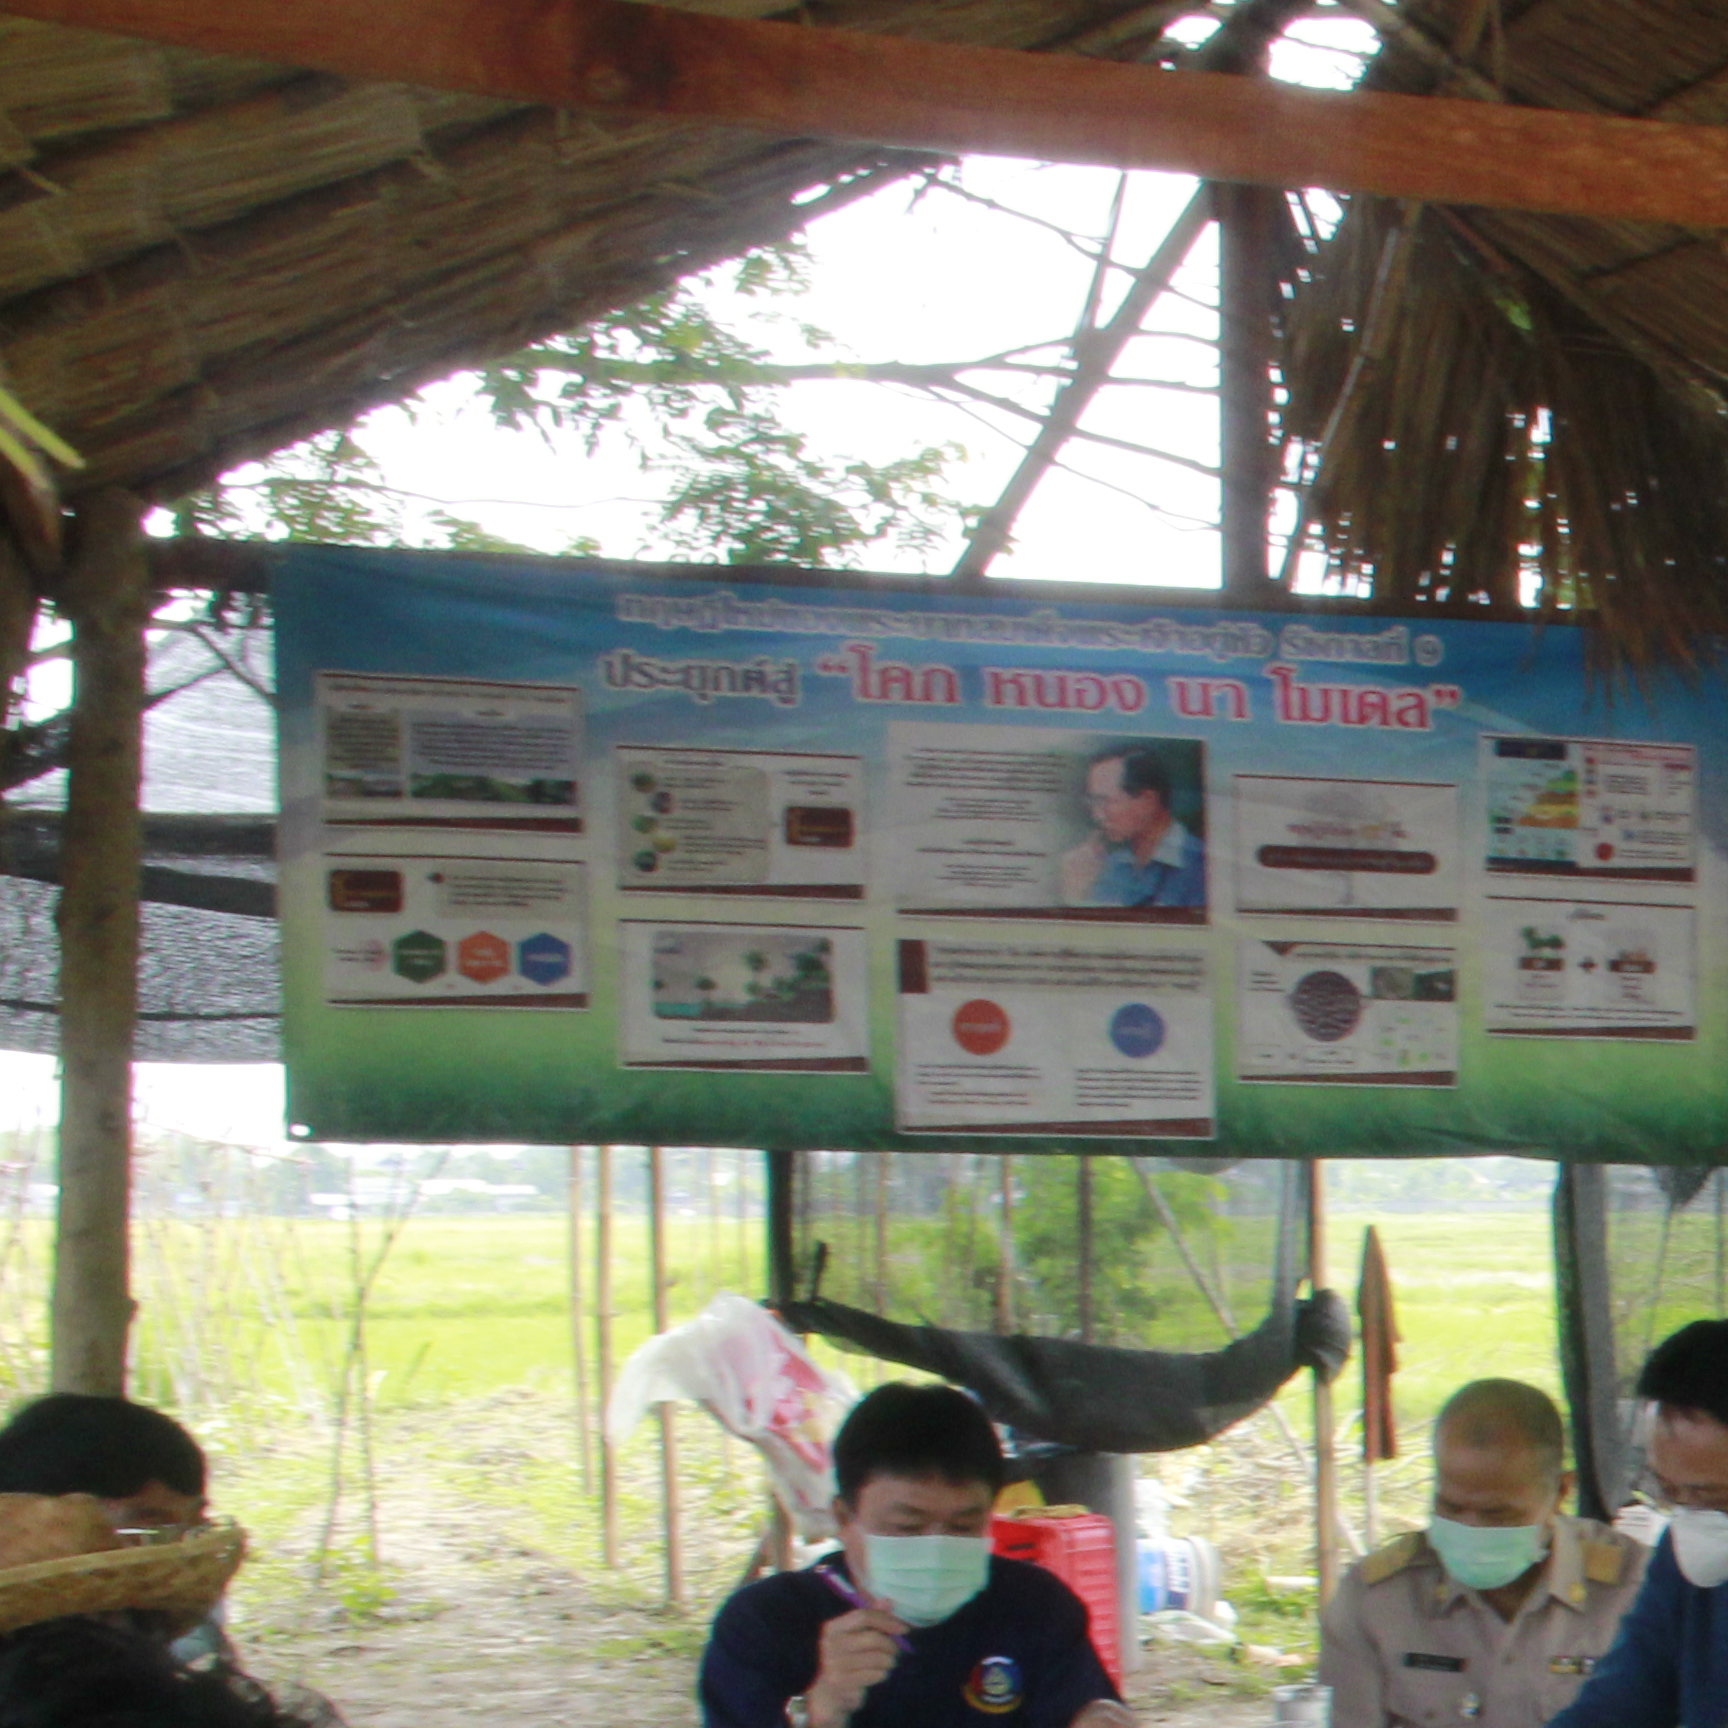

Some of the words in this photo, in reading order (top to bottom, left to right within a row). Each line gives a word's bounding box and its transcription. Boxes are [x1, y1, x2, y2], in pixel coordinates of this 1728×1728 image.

[603, 651, 798, 706] ประยุกต์สู่
[988, 669, 1145, 713] หนอง
[1169, 677, 1250, 721] นา
